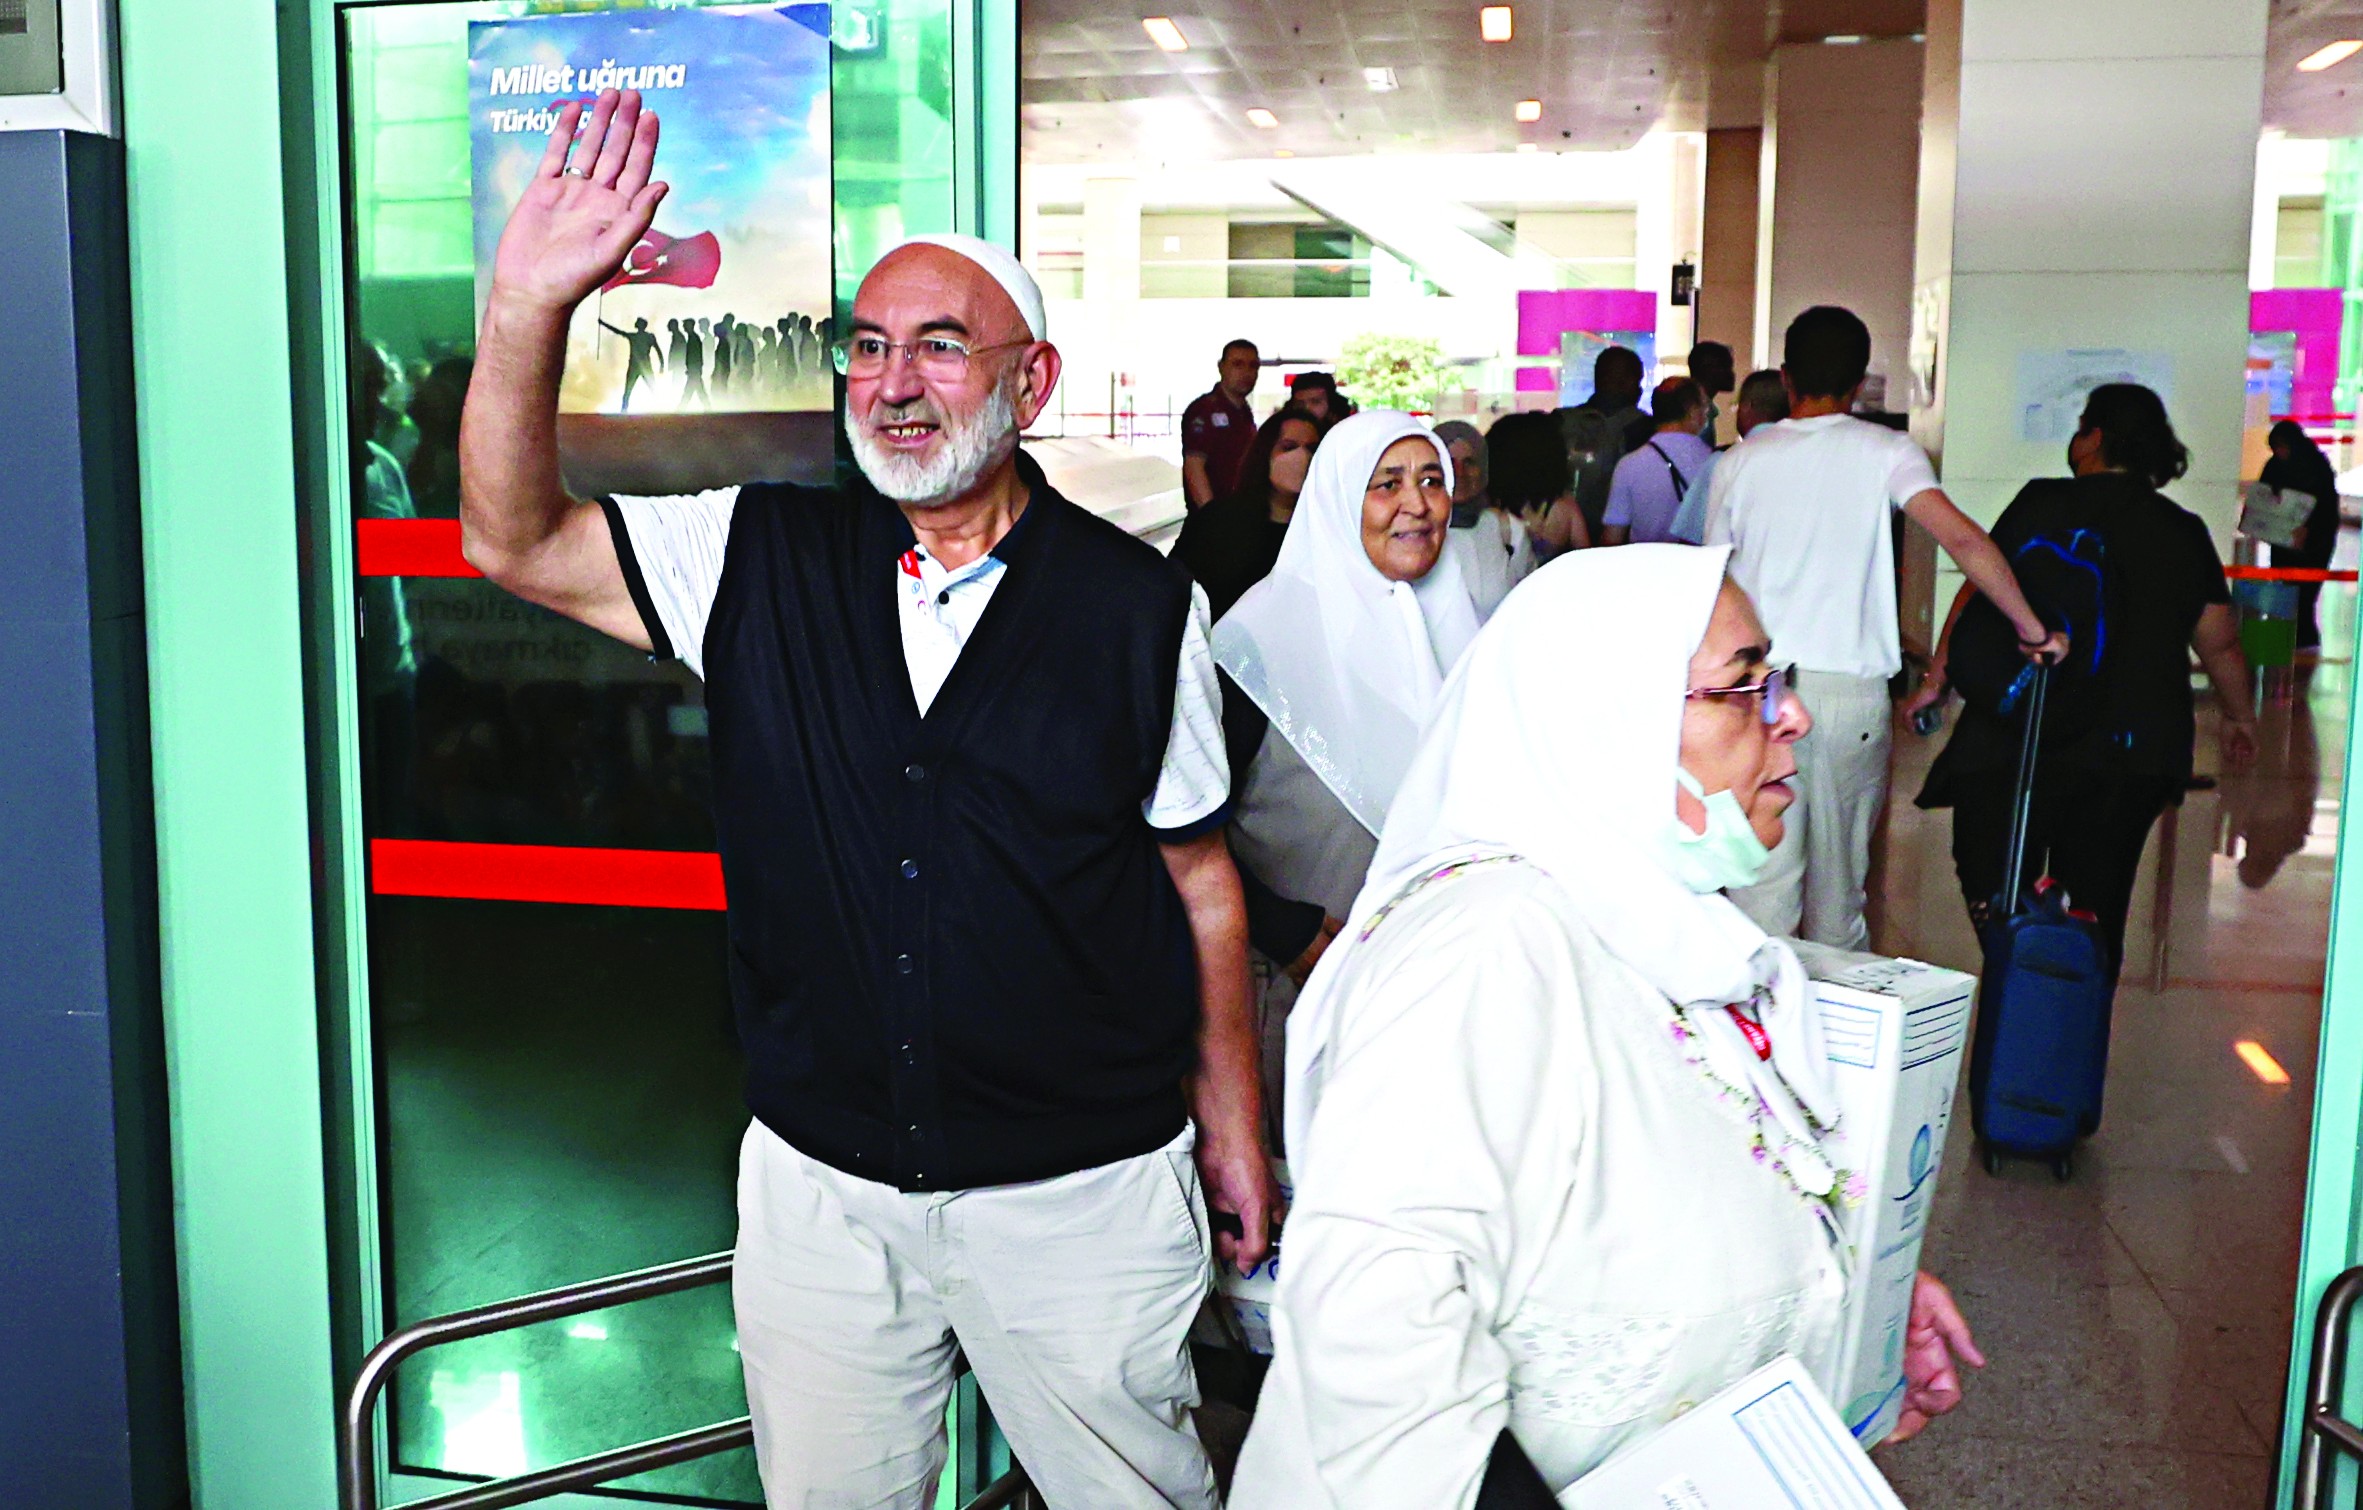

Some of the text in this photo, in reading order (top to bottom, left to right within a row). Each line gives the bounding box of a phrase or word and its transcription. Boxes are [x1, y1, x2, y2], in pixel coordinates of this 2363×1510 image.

[490, 58, 686, 96] Millet uğruna
[490, 108, 563, 136] Türkiy
